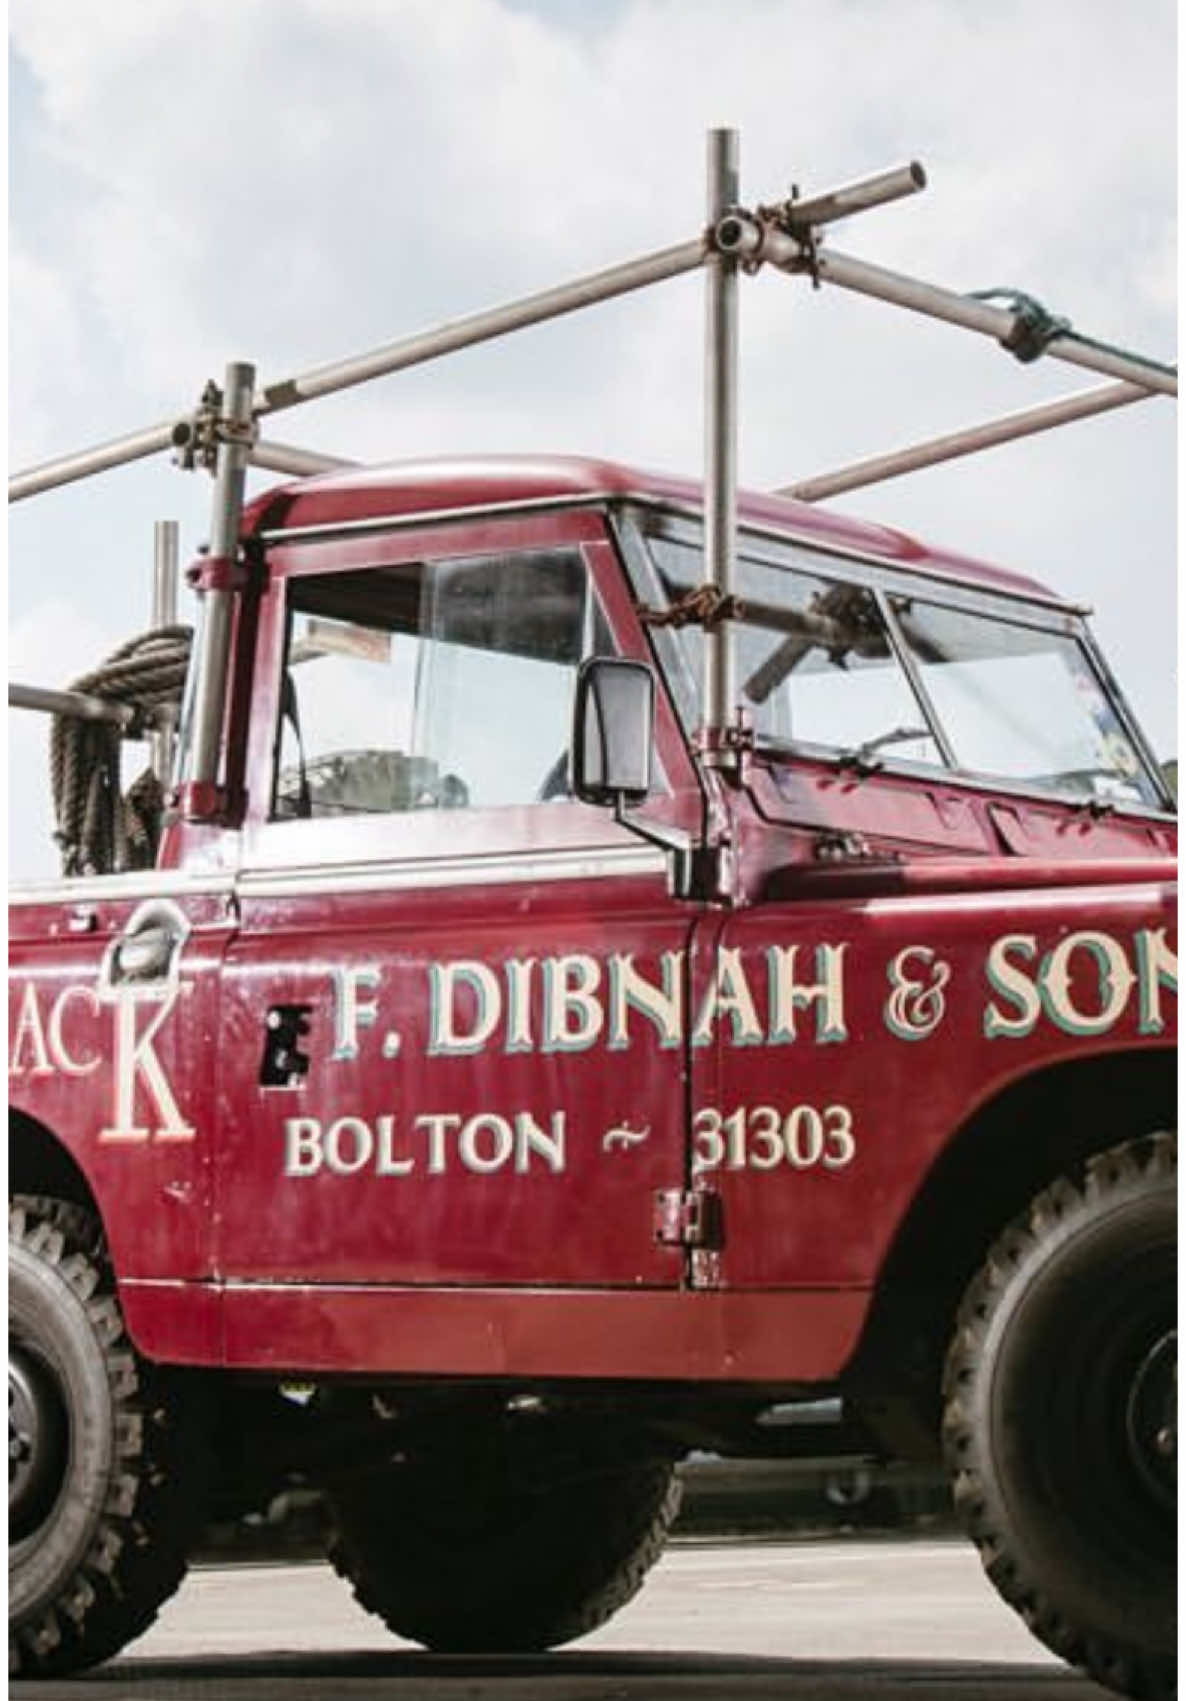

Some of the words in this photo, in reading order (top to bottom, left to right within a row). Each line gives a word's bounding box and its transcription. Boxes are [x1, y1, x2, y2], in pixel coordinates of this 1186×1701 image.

[331, 965, 400, 1061] F.
[427, 942, 848, 1055] DIBNAH
[885, 945, 951, 1041] &
[285, 1111, 566, 1176] BOLTON
[692, 1105, 856, 1172] 31303
